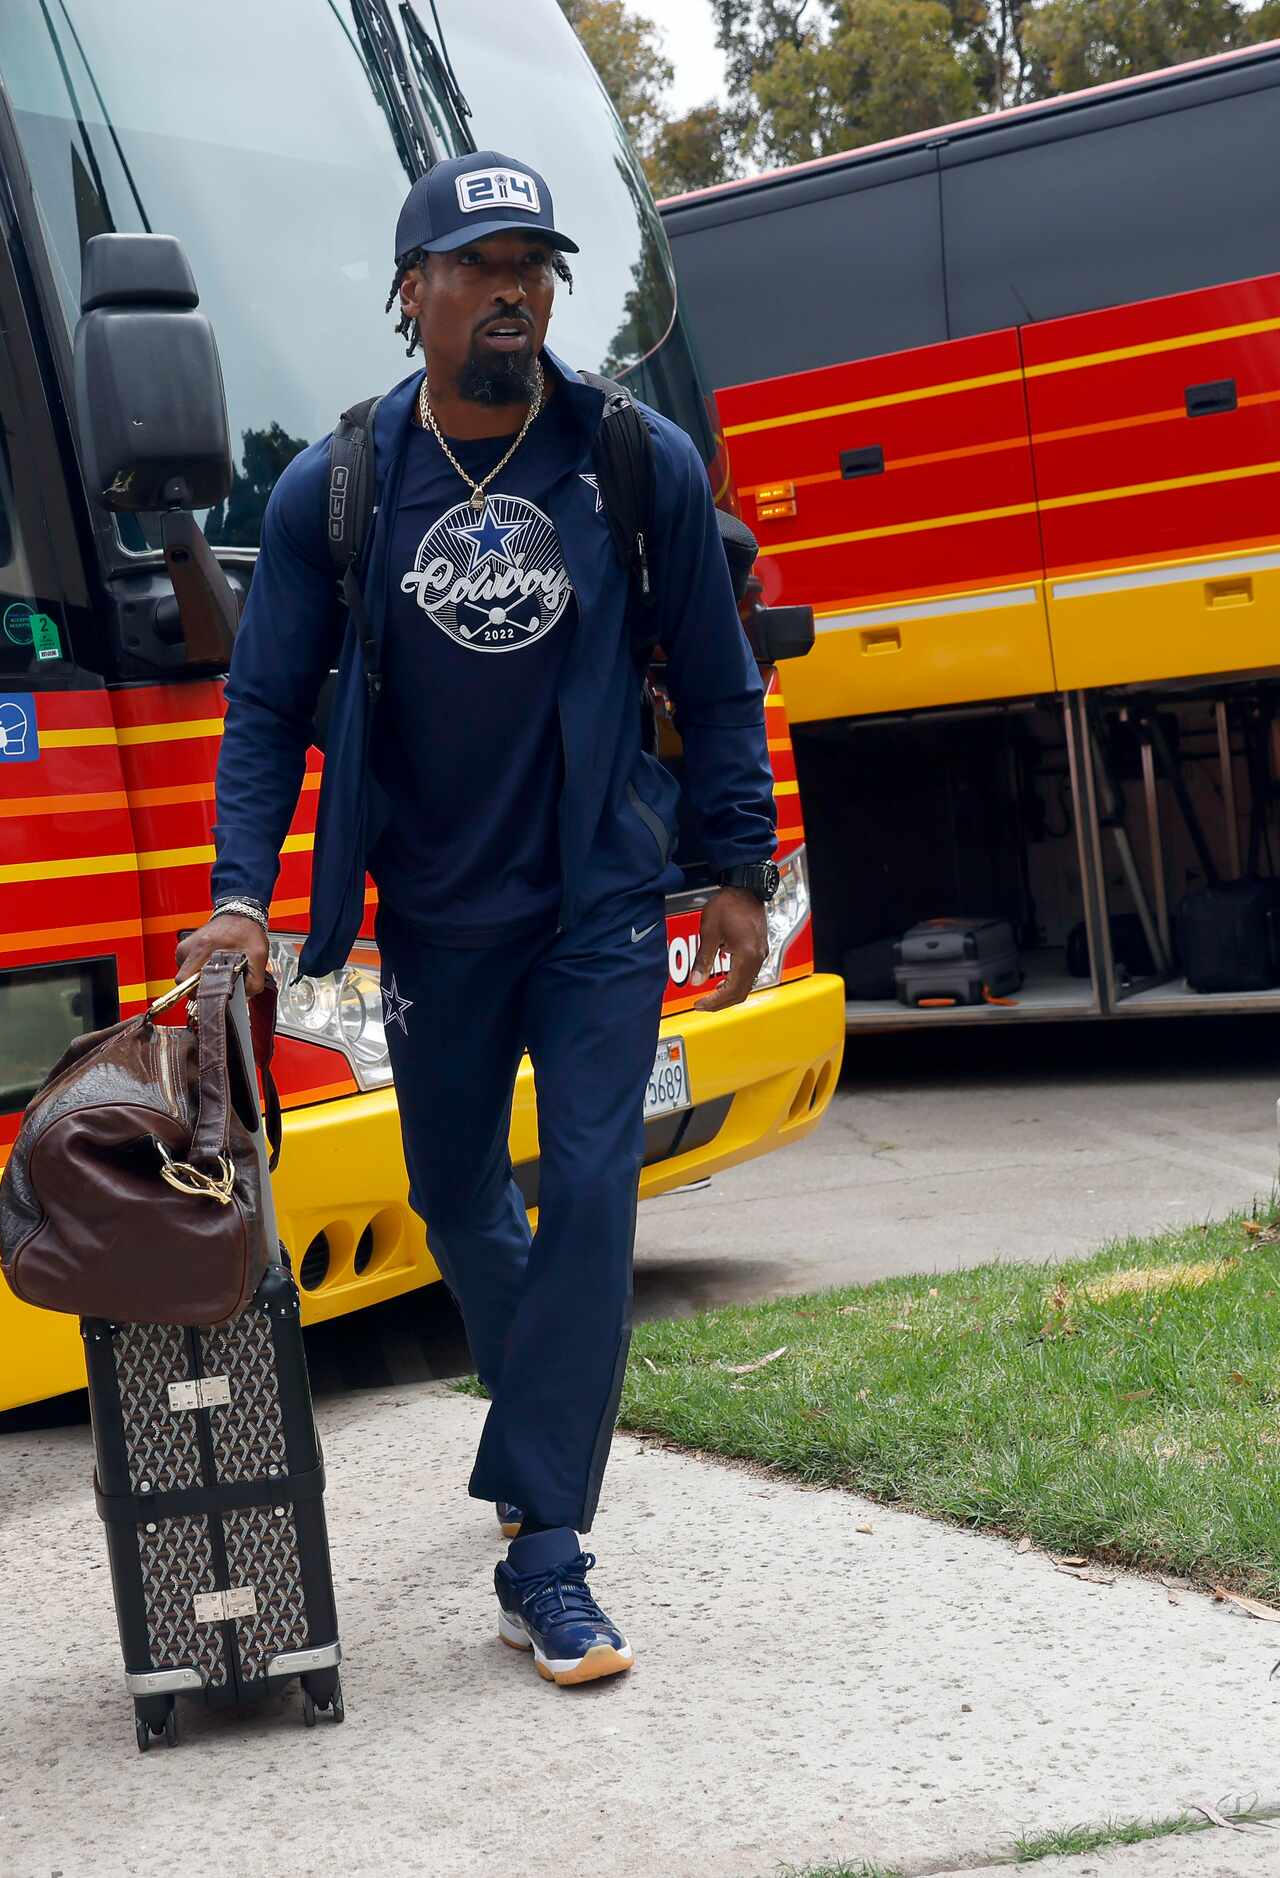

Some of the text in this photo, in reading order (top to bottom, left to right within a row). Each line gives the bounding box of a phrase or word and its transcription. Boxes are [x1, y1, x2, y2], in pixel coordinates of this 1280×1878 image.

[328, 466, 349, 541] OGIO
[39, 617, 49, 632] 2
[484, 629, 514, 641] 2022
[644, 1064, 682, 1106] 5689
